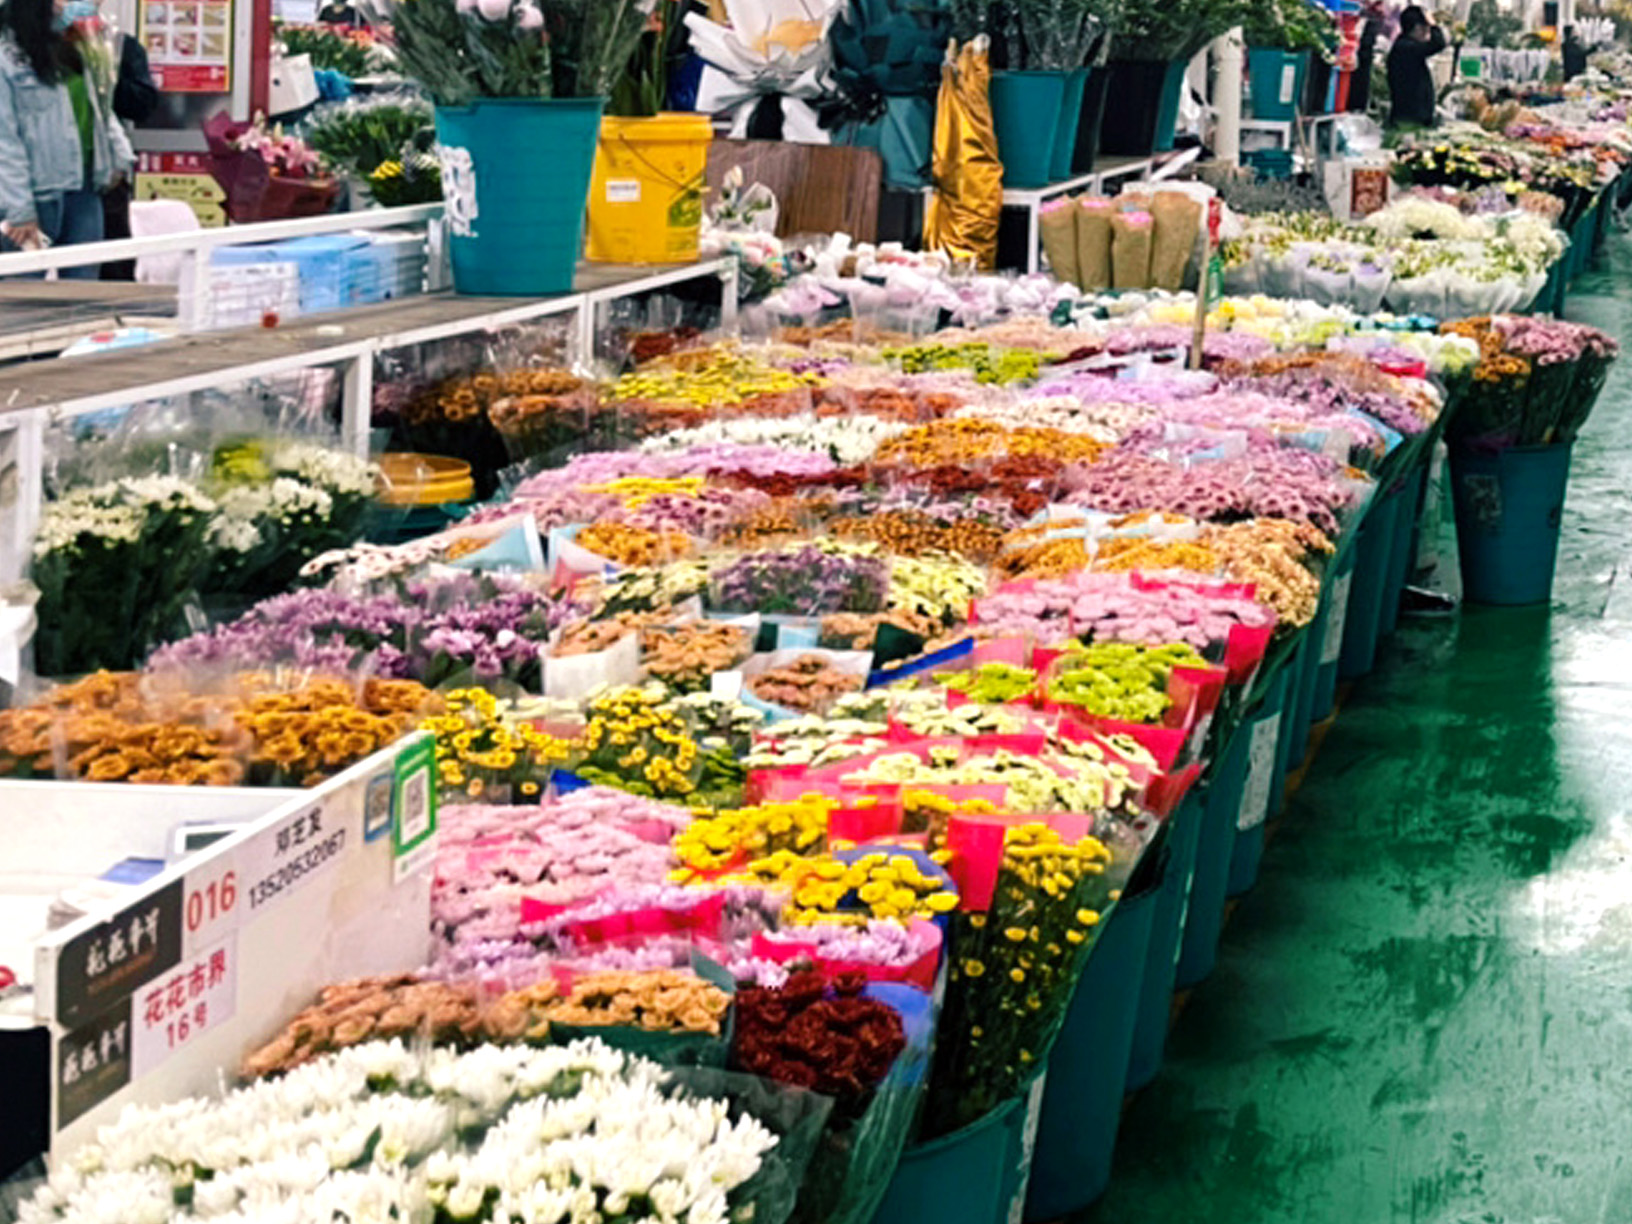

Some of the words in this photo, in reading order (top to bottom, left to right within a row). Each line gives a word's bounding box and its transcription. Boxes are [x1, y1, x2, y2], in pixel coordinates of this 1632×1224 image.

[187, 871, 236, 931] 016
[144, 948, 226, 1028] 花花市界
[167, 1001, 208, 1049] 16号
